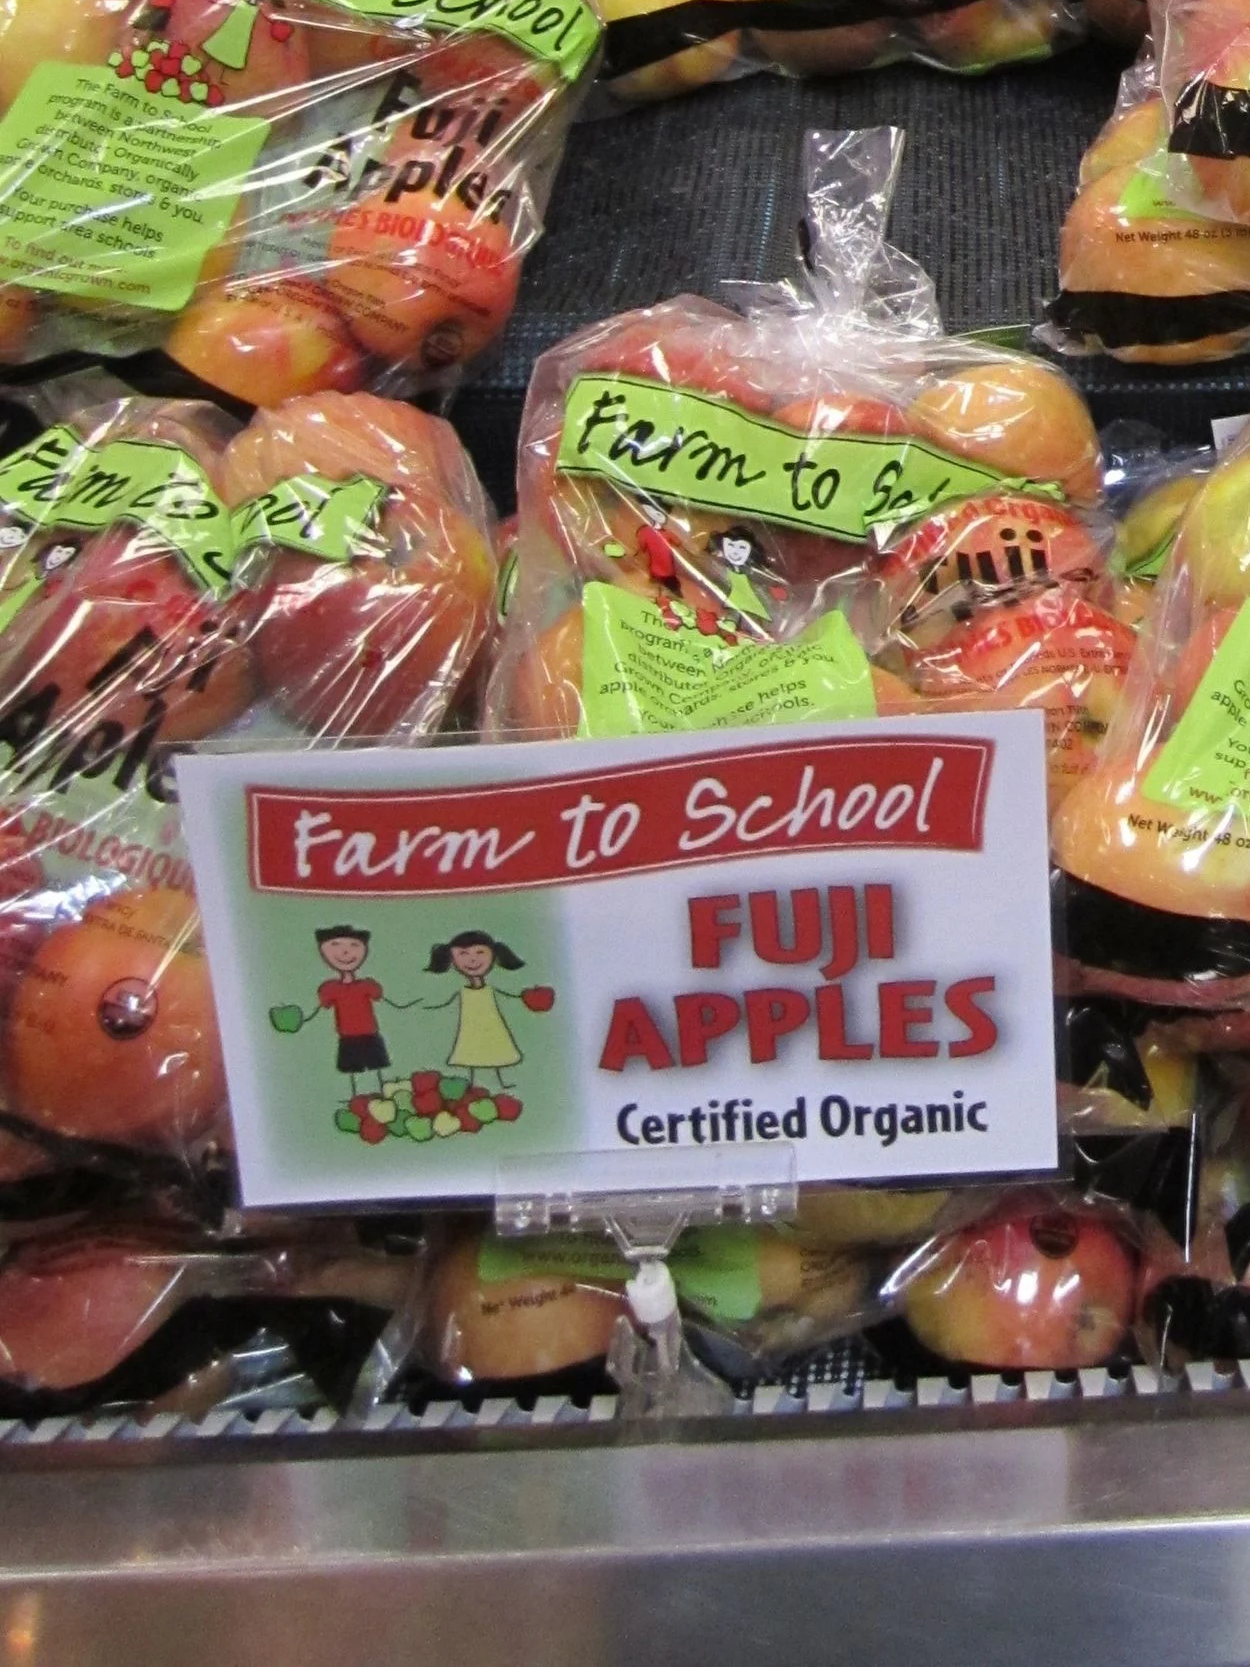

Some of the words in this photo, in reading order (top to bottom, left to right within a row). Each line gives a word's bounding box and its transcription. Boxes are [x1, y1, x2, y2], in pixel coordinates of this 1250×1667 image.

[576, 388, 766, 487] Farm
[783, 455, 841, 511] to
[293, 809, 537, 880] Farm
[559, 793, 641, 869] to
[676, 756, 945, 852] School
[687, 882, 897, 980] FUJI
[597, 975, 1001, 1073] APPLES
[615, 1094, 807, 1146] Certified
[820, 1090, 990, 1147] Organic
